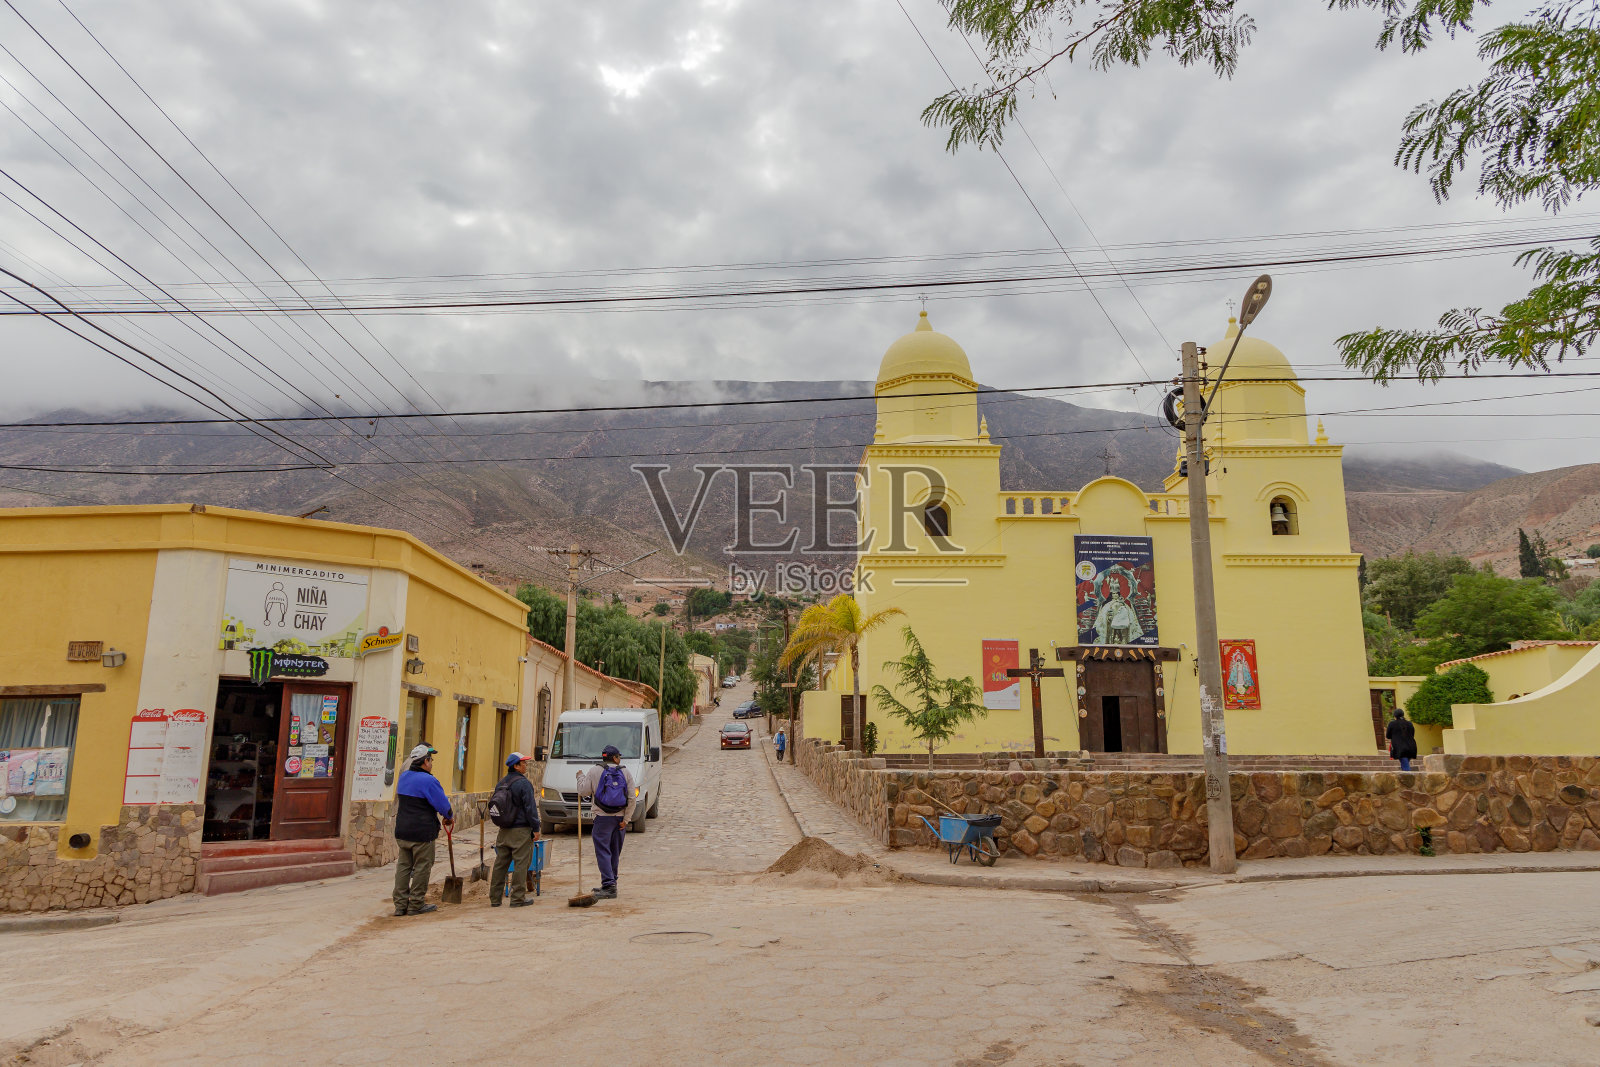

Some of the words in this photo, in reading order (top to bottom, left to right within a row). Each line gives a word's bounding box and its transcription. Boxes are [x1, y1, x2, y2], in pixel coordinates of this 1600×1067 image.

[256, 563, 345, 580] MINIMERCADITO
[297, 586, 328, 606] NIÑA
[294, 614, 327, 631] CHAY
[274, 657, 325, 669] MONSTER
